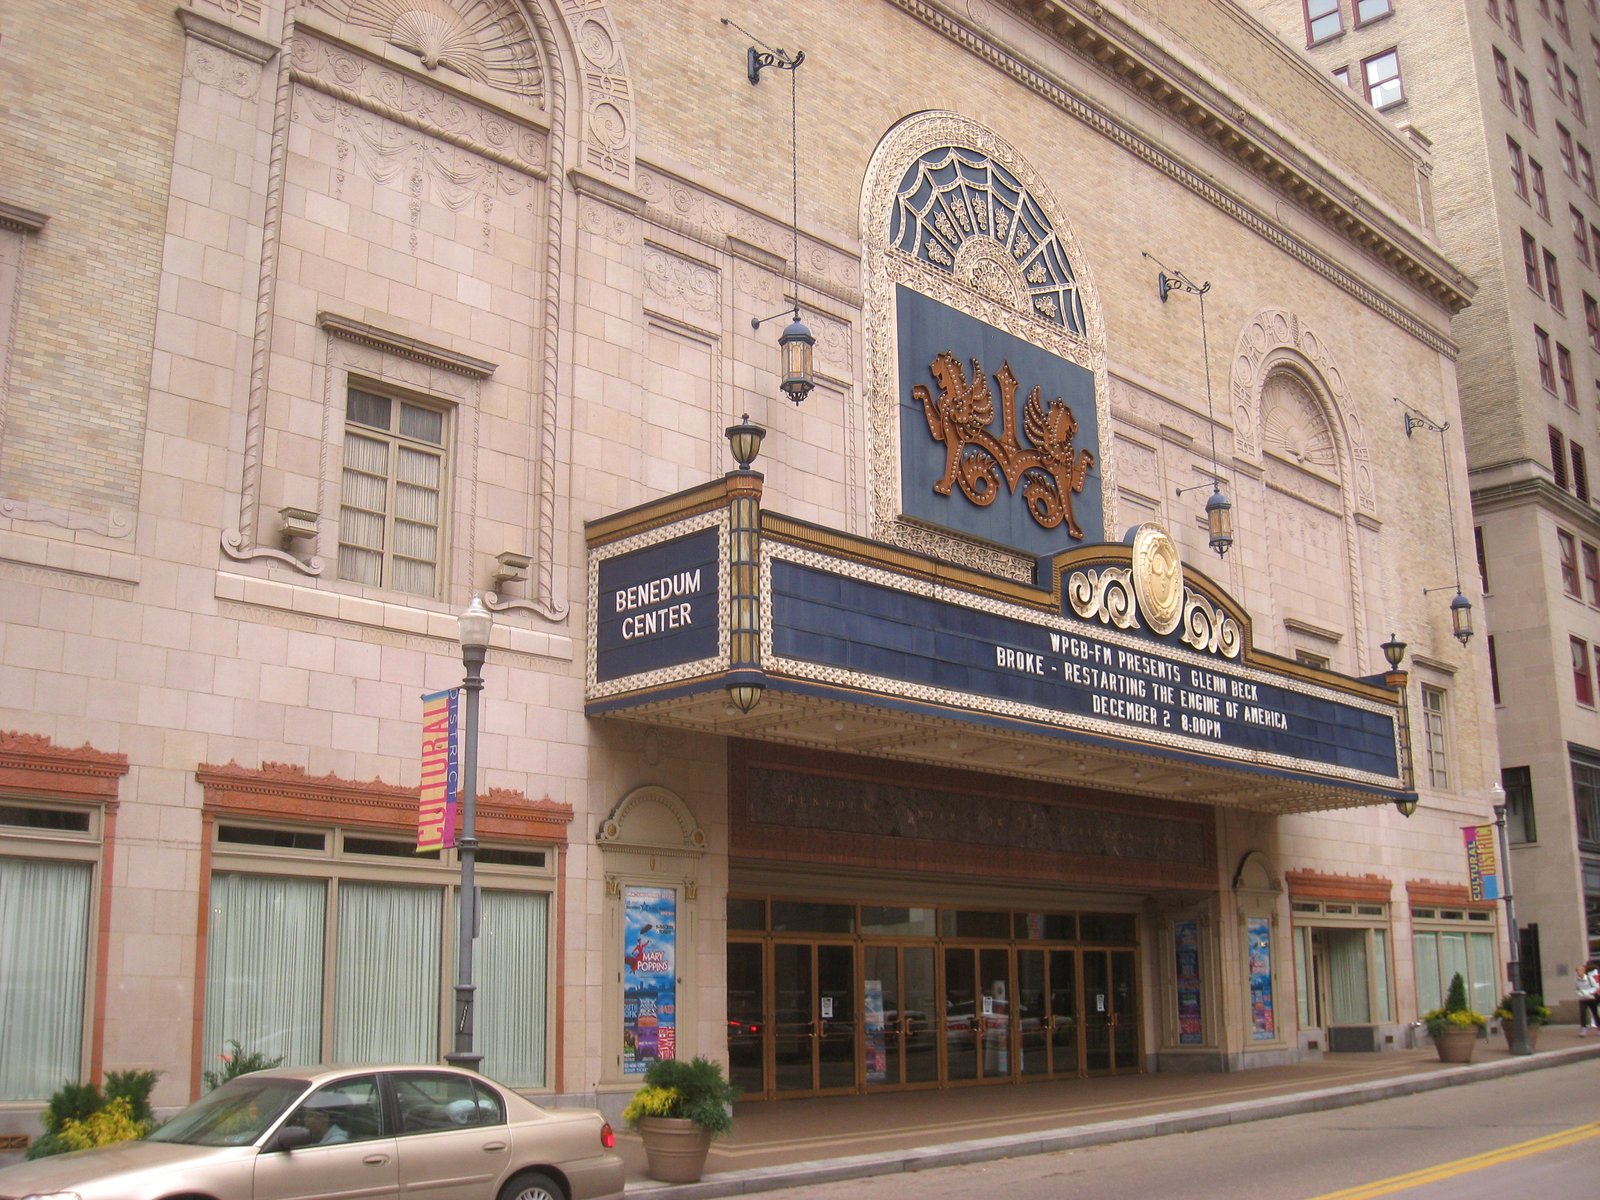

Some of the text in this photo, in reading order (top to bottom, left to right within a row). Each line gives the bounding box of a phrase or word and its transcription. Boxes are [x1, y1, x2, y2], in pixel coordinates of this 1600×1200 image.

[615, 569, 701, 613] BENEDUM
[622, 602, 692, 640] CENTER
[996, 646, 1045, 675] BROKE
[1064, 662, 1146, 698] RESTARTING
[1152, 683, 1175, 705] THE
[1180, 690, 1221, 716] ENGINE
[1226, 702, 1239, 719] OF
[1244, 706, 1288, 731] AMERICA
[1050, 632, 1258, 702] WPGB-FM PRESENTS GLENN BECK
[1092, 694, 1222, 739] DECEMBER 2 8:00PM
[448, 688, 459, 798] DISTRICT
[418, 698, 449, 847] CULTURAL
[1469, 841, 1481, 900] CULTURAL
[637, 960, 669, 972] POPPINS
[642, 951, 664, 962] MARY
